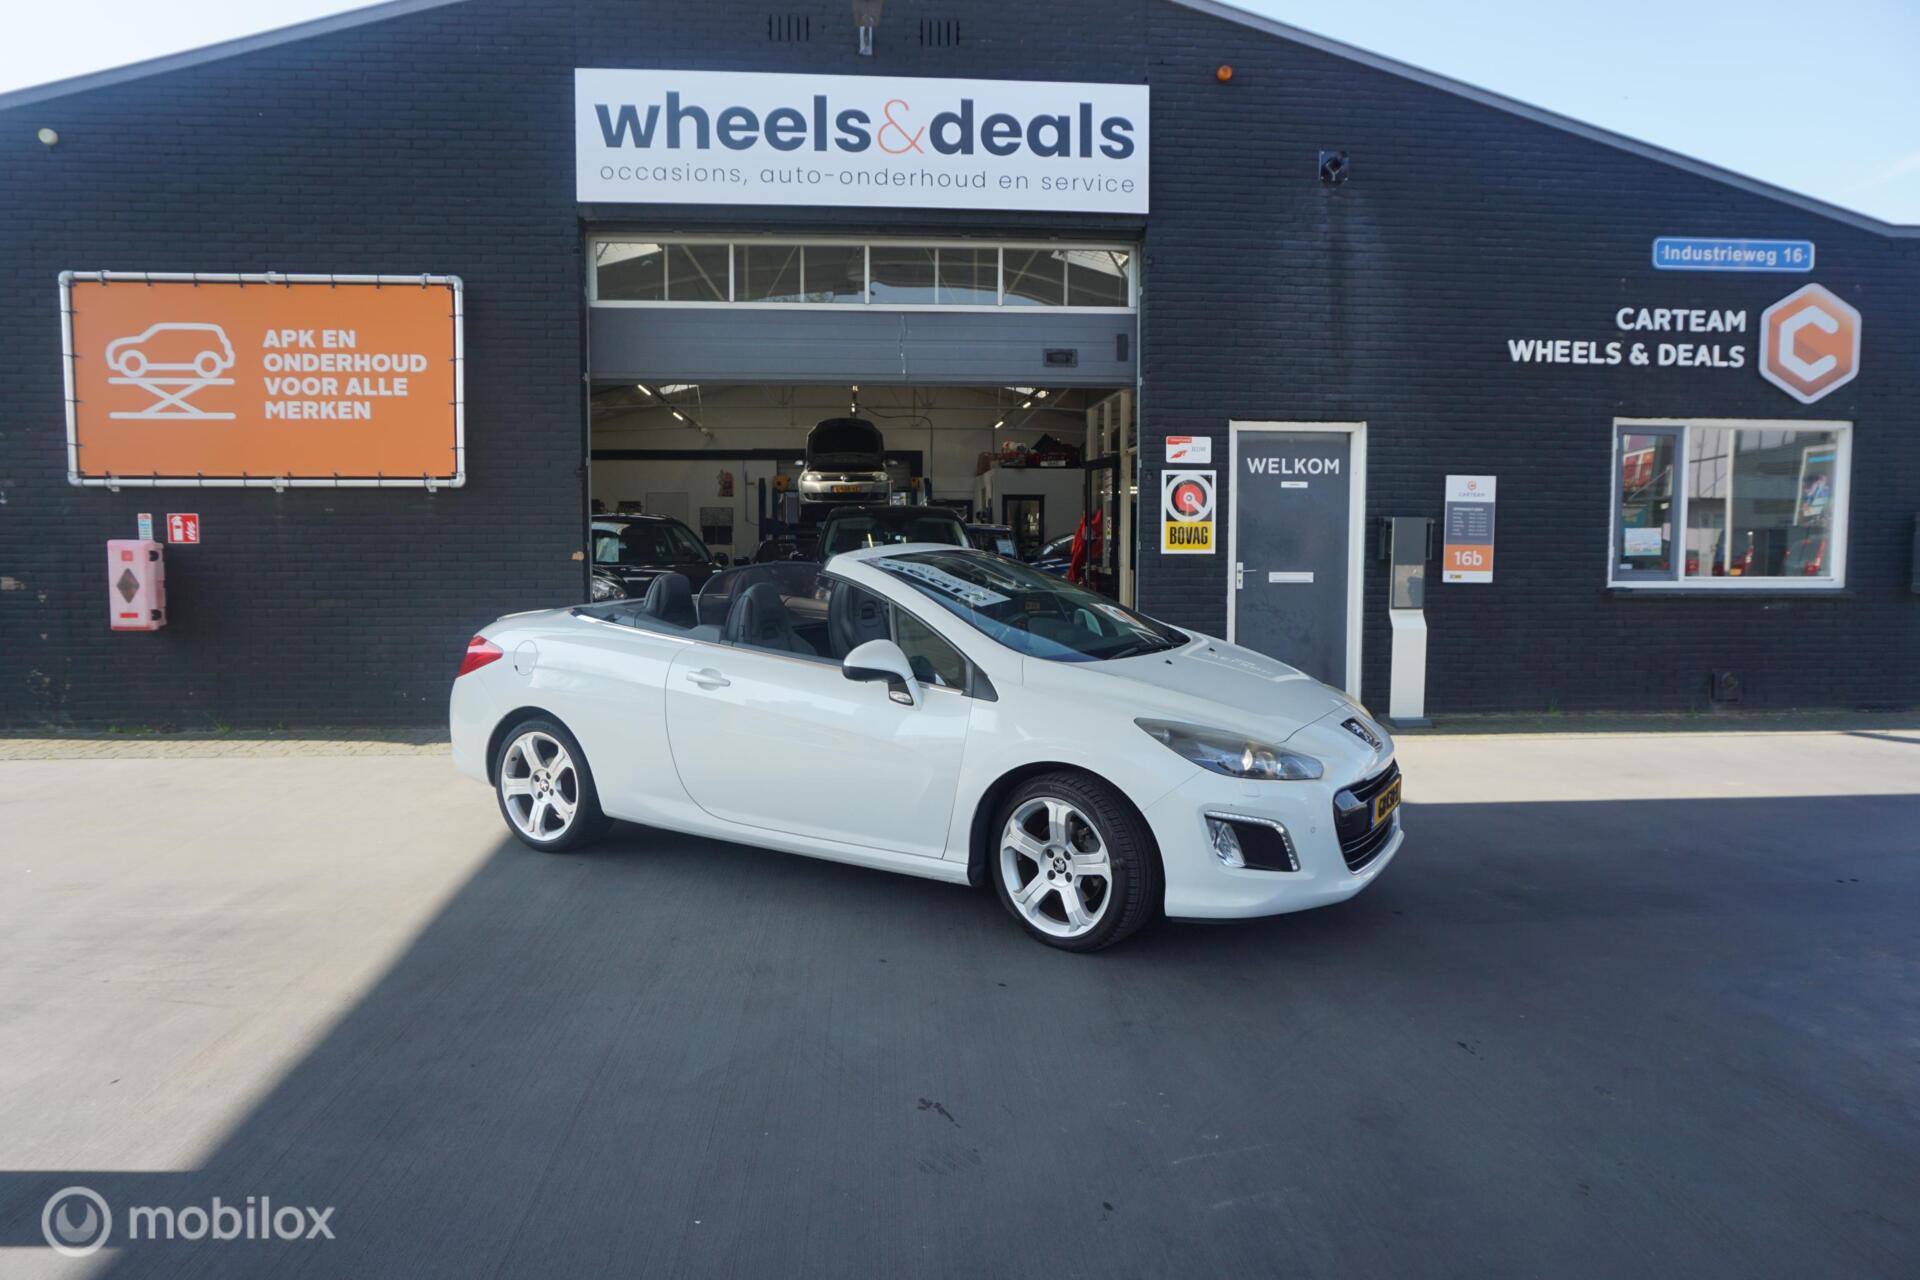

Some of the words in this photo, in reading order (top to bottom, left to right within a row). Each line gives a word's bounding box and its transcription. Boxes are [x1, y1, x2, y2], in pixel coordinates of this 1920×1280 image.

[600, 163, 748, 186] occasions,
[760, 165, 986, 189] auto-onderhoud
[999, 175, 1028, 189] en
[1041, 174, 1135, 193] service
[1664, 245, 1776, 266] Industrieweg
[1784, 248, 1802, 262] 16
[1616, 307, 1747, 333] CARTEAM
[263, 330, 316, 349] APK
[322, 330, 356, 349] EN
[263, 353, 427, 373] ONDERHOUD
[1507, 339, 1622, 365] WHEELS
[1629, 343, 1649, 365] &
[1657, 344, 1745, 368] DEALS
[263, 377, 339, 396] VOOR
[346, 377, 409, 396] ALLE
[265, 401, 372, 420] MERKEN
[1246, 457, 1340, 475] WELKOM
[1169, 526, 1208, 544] BOVAG
[1454, 550, 1483, 566] 16b
